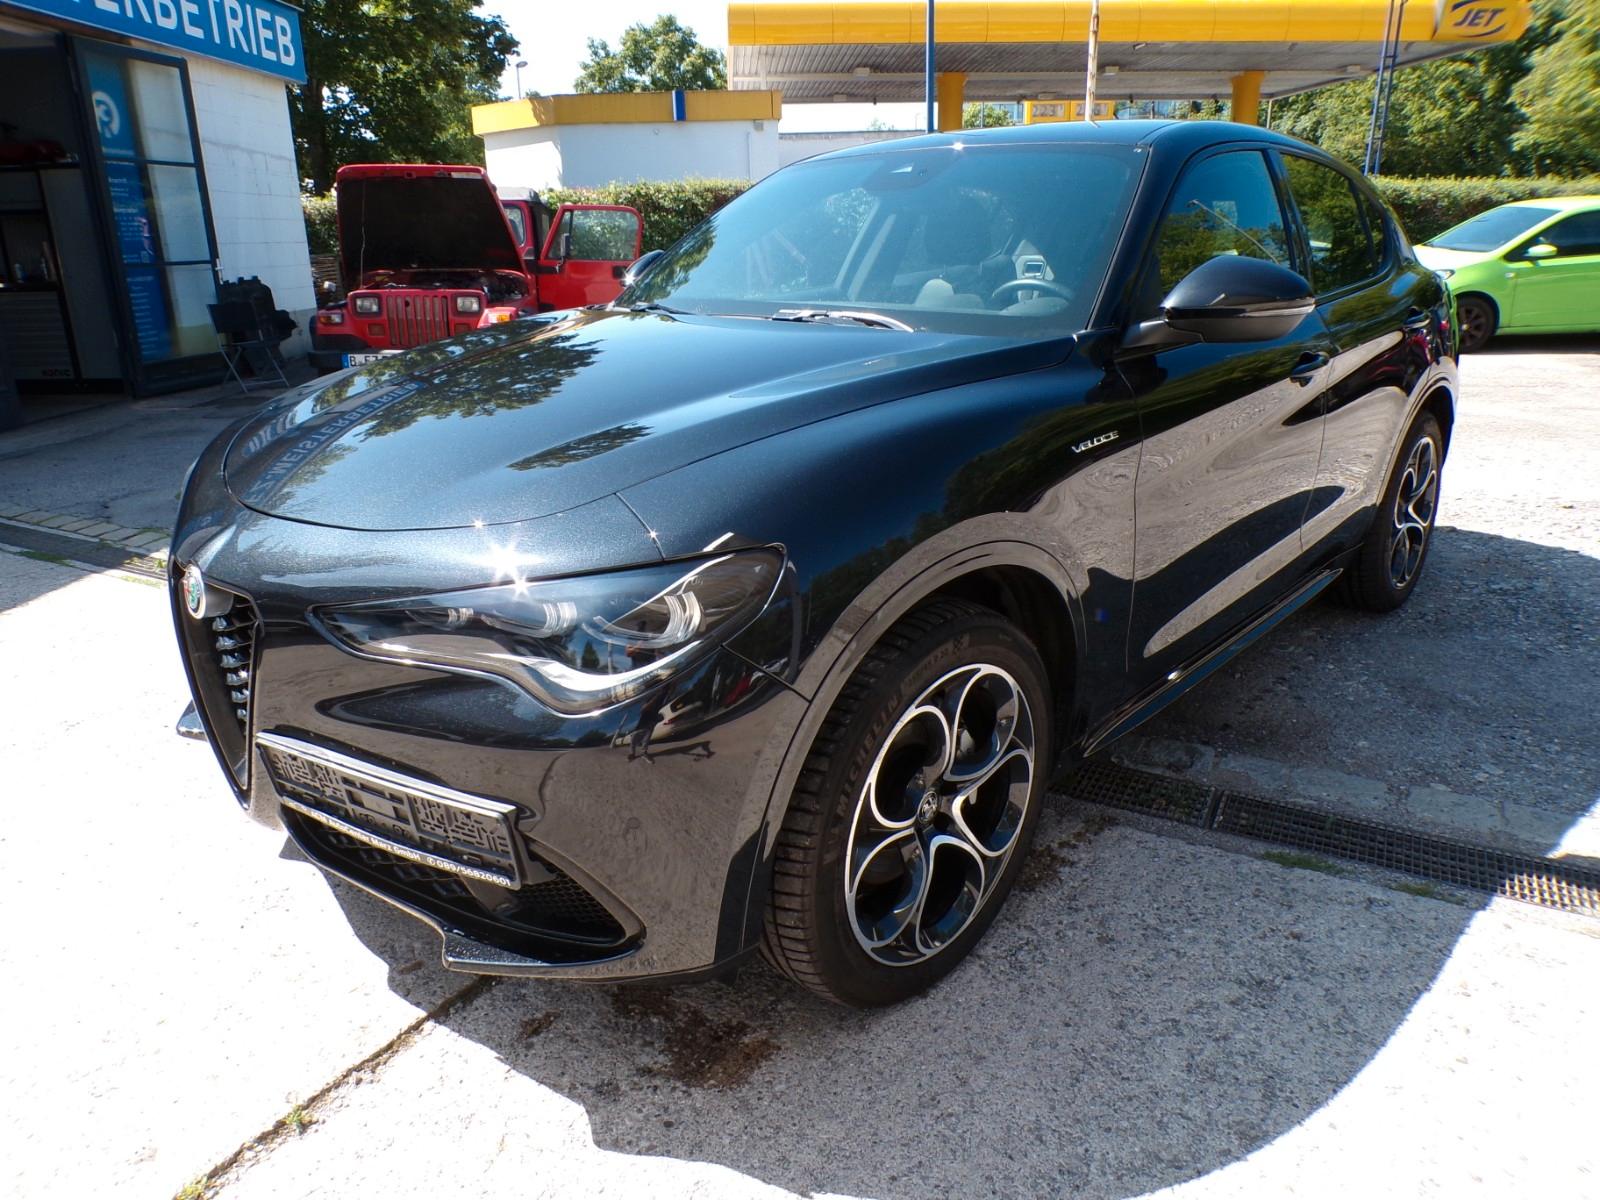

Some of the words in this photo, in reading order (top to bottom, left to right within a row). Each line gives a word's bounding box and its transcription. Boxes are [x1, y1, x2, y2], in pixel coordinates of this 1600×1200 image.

[1453, 8, 1506, 27] JET
[1071, 430, 1120, 453] VELOCE
[836, 695, 899, 817] MICHELIN
[393, 846, 421, 861] GmbH
